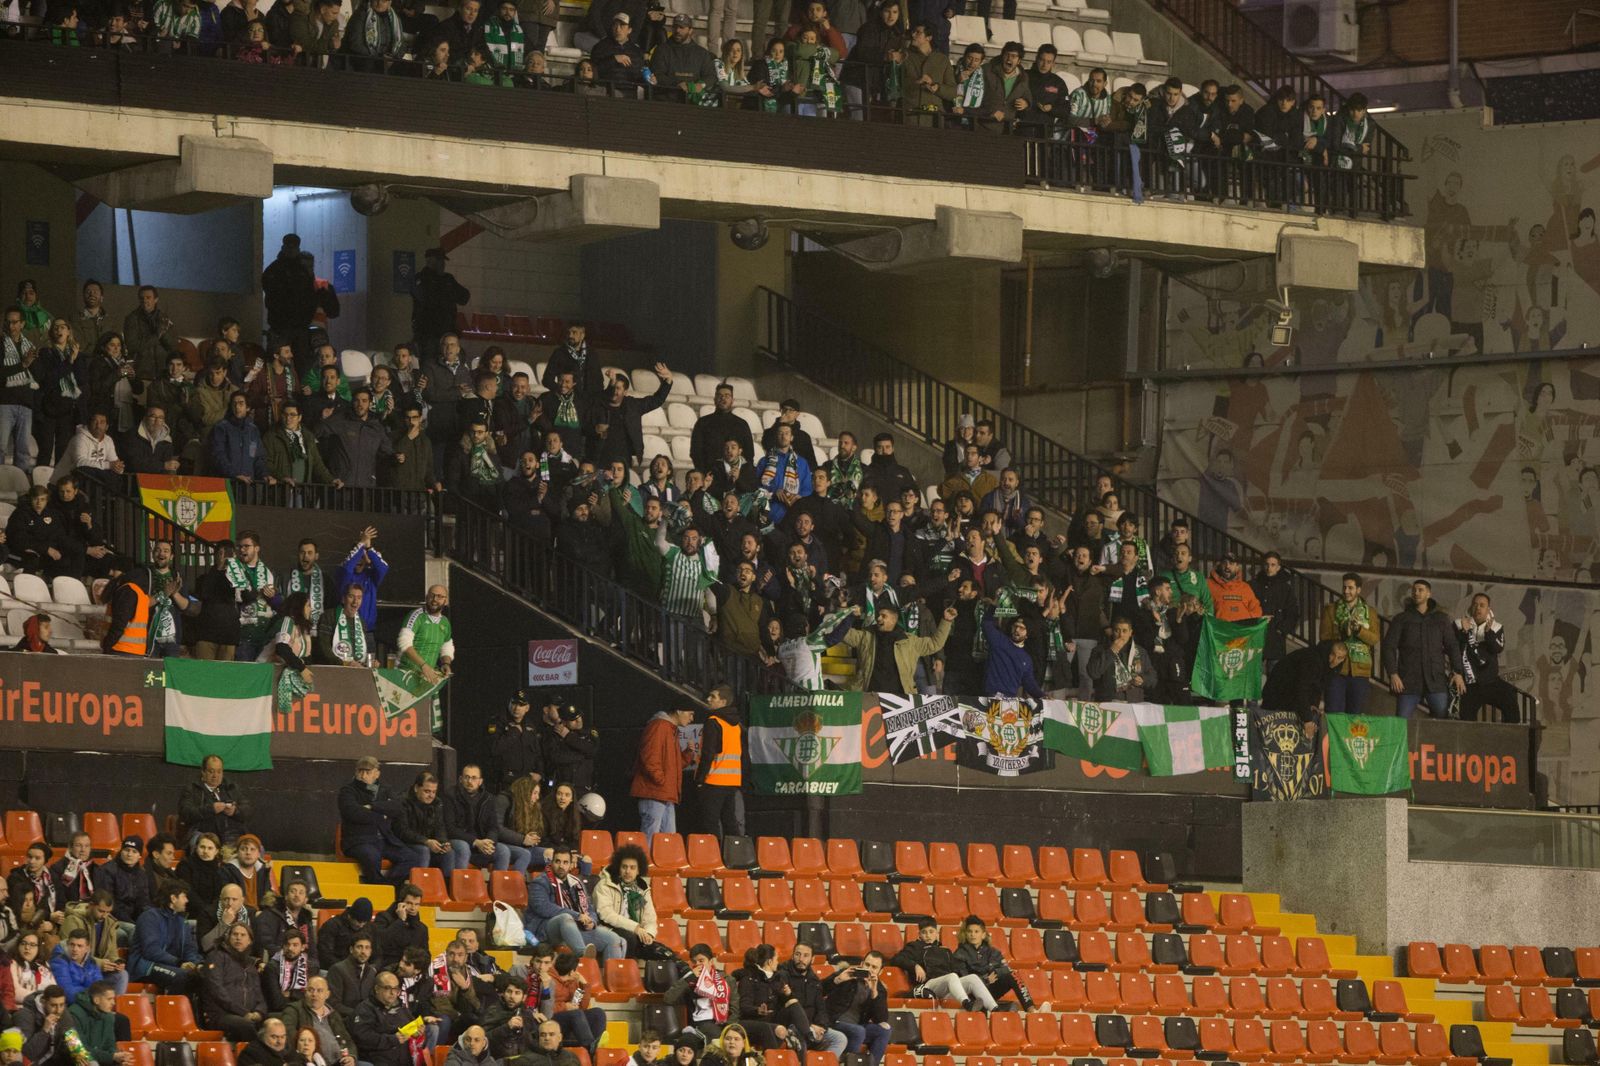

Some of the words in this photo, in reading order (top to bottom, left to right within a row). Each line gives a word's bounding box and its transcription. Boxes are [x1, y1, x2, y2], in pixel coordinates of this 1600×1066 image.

[545, 673, 560, 681] BAR
[769, 694, 844, 708] ALMEDINILLA
[775, 781, 839, 795] CARCABUEY
